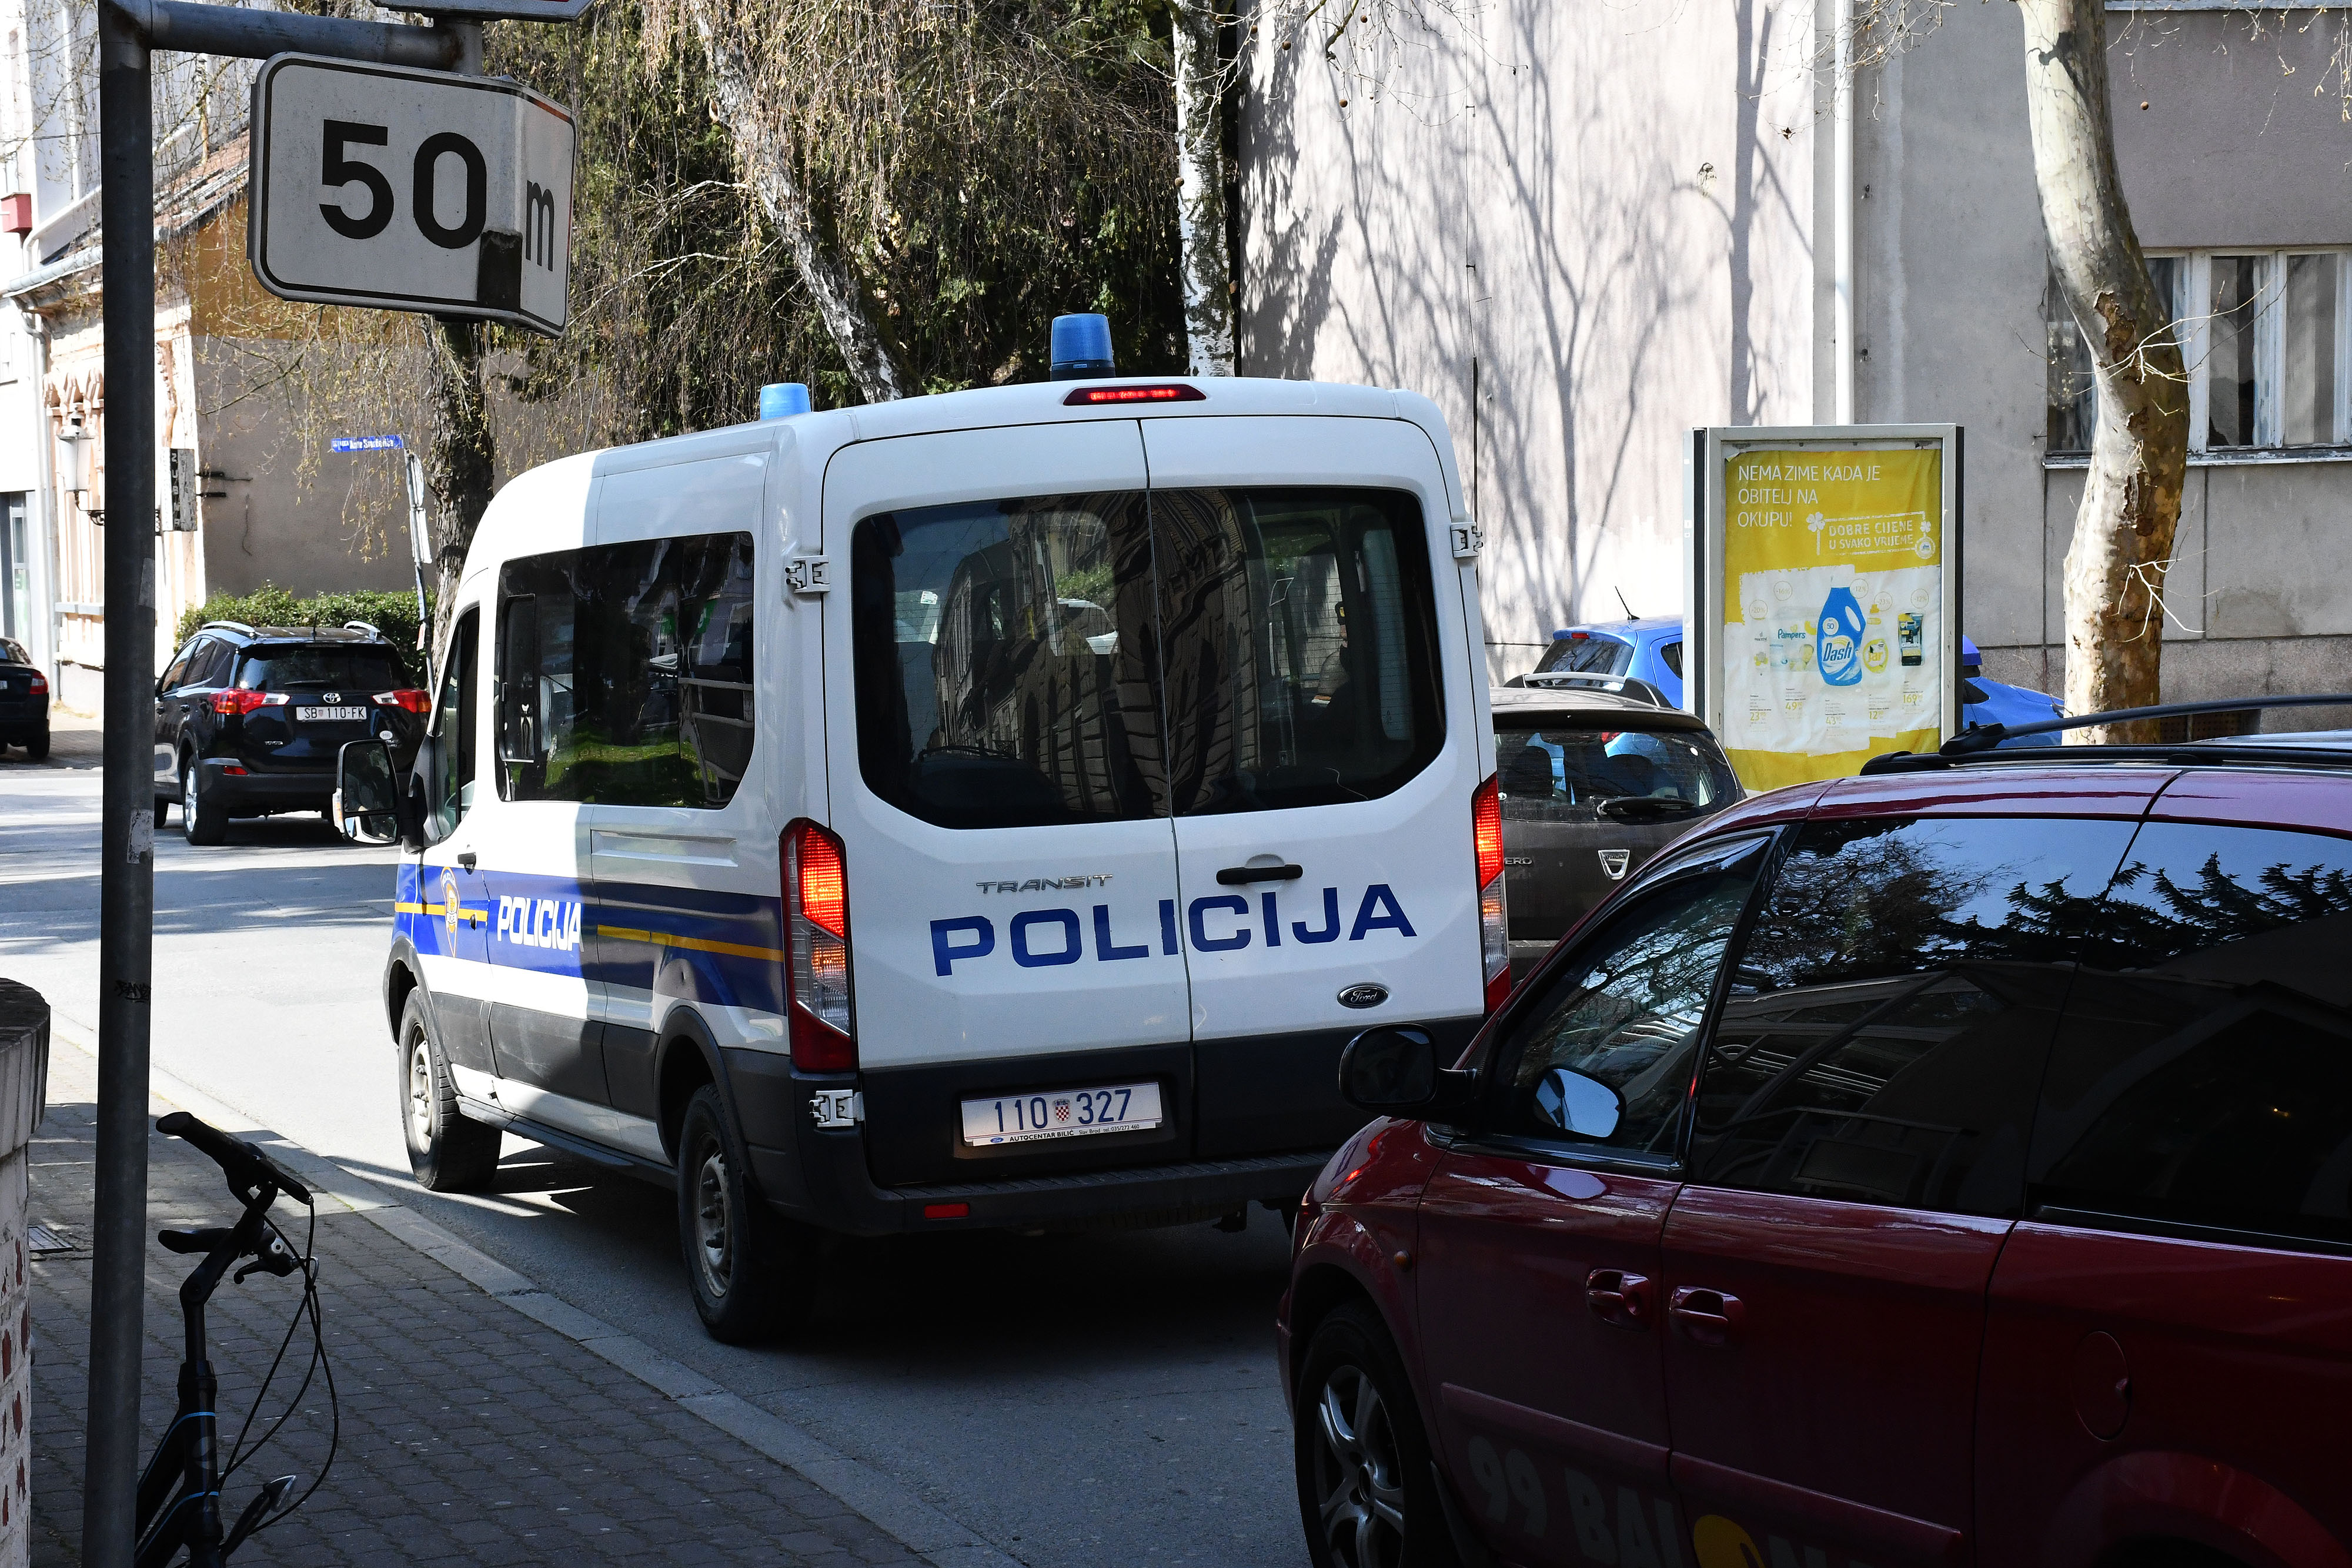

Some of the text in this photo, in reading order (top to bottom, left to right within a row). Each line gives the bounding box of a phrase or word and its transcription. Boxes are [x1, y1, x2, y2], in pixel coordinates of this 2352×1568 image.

[319, 119, 554, 272] 50 m
[1739, 465, 1881, 482] NEMA ZIME KADA JE
[1738, 489, 1819, 505] OBITELJ NA
[1738, 511, 1793, 527] OKUPU!
[1829, 520, 1913, 537] DOBRE CIJENE
[1829, 534, 1913, 550] U SVAKO VRIJEME
[1778, 628, 1806, 640] Pampers
[1823, 641, 1852, 661] Dash
[304, 706, 365, 718] SB 110-FK
[975, 874, 1113, 894] TRANSIT
[497, 895, 584, 952] POLICIJA
[930, 884, 1418, 977] POLICIJA
[1350, 989, 1378, 1002] Ford
[995, 1088, 1131, 1132] 110 327
[1009, 1132, 1056, 1142] AUTOCENTAR
[1057, 1128, 1074, 1137] BILIĆ
[1468, 1435, 1548, 1539] 99
